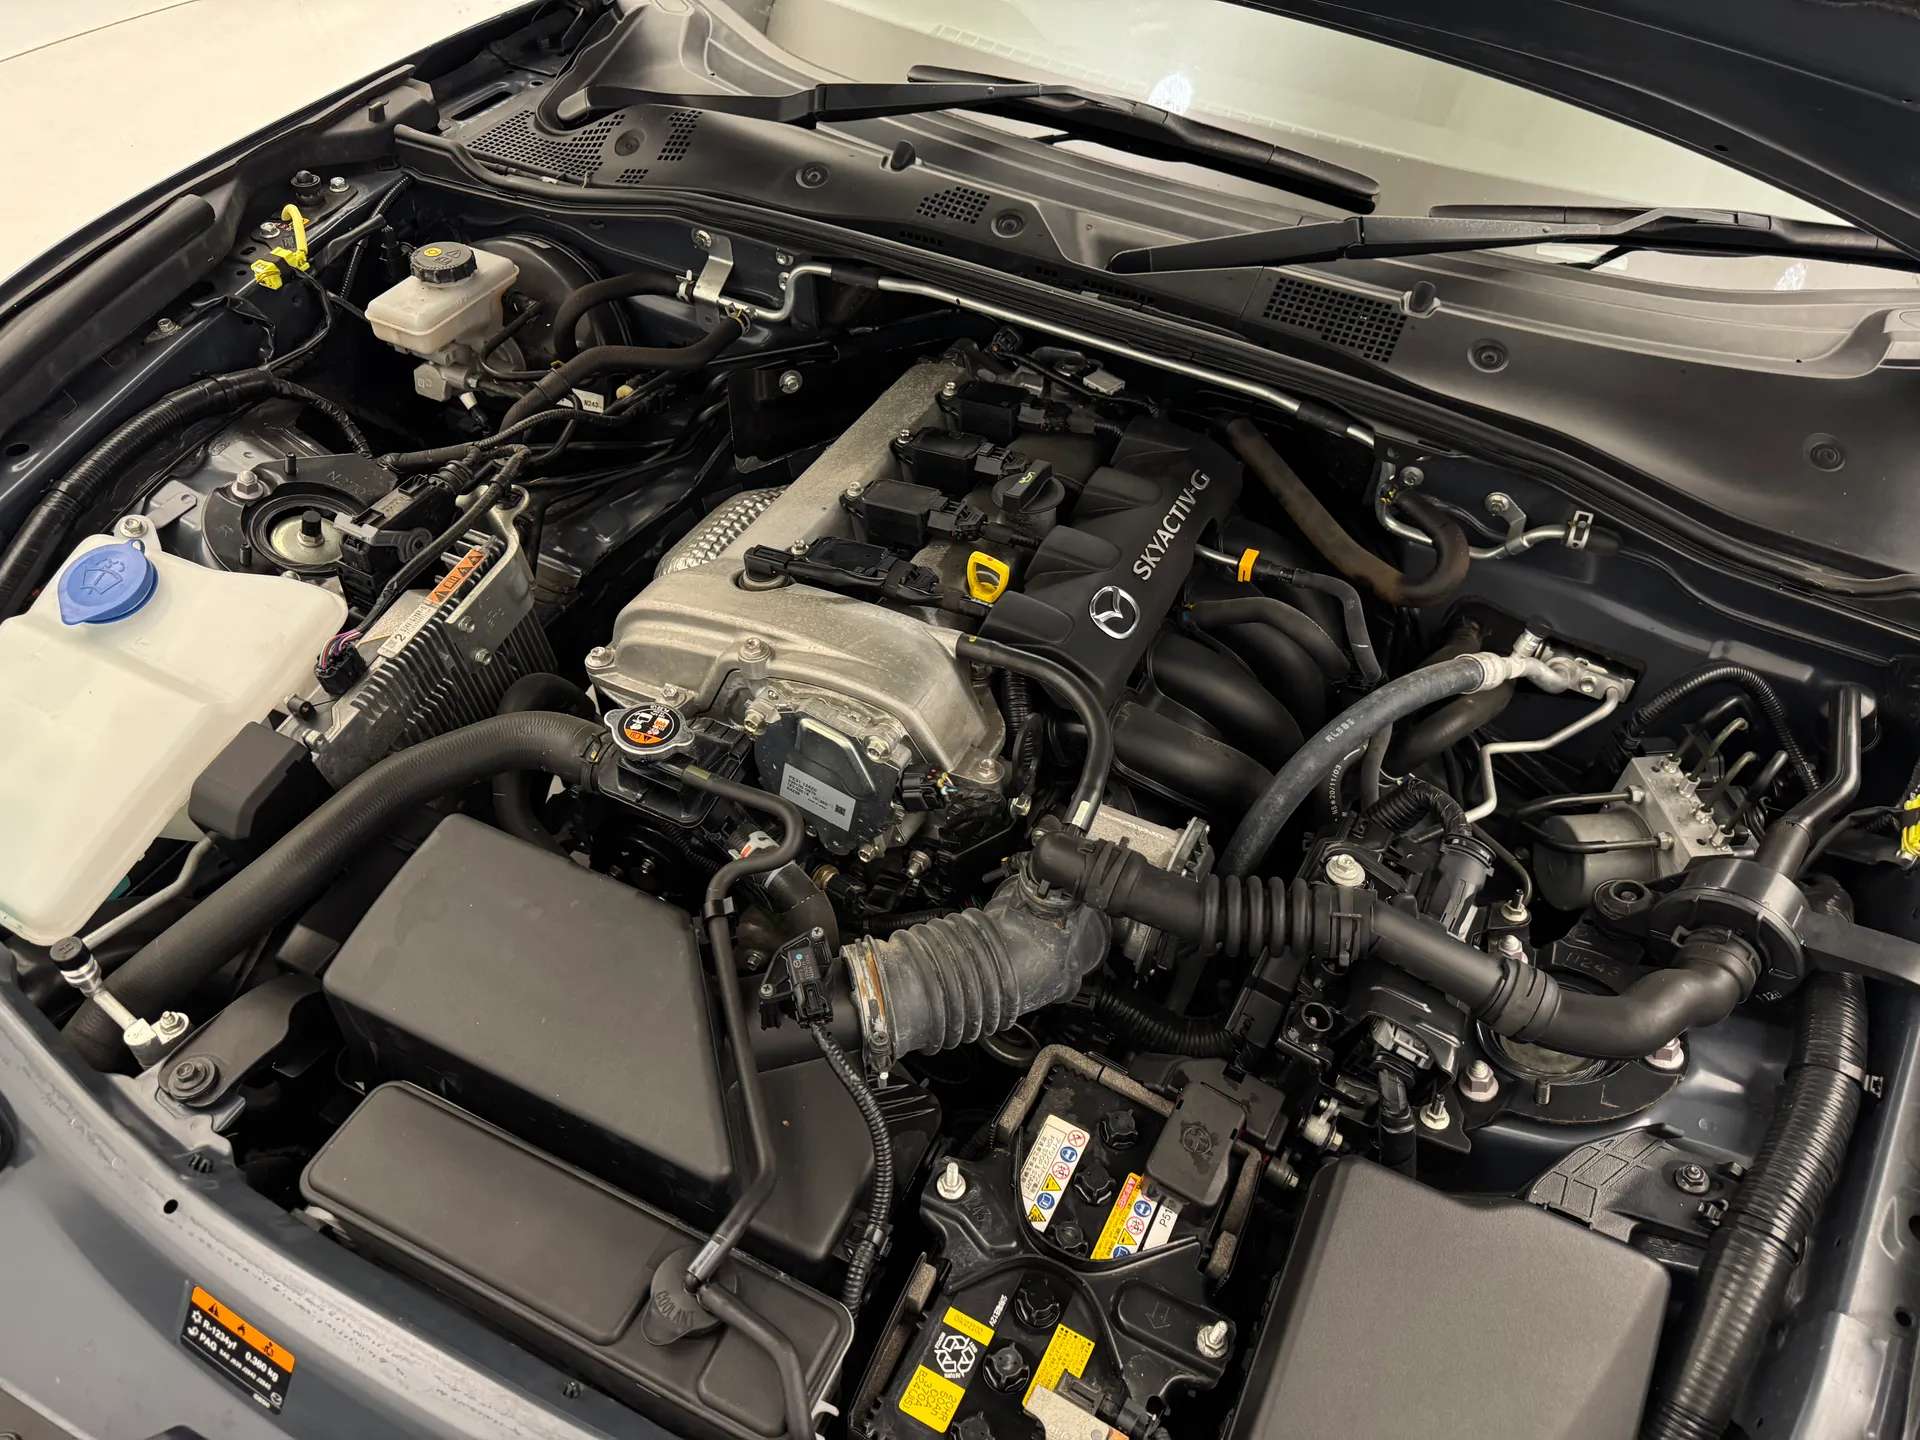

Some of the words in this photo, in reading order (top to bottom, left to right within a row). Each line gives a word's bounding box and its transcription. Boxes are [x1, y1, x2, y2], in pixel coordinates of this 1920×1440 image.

[1133, 469, 1210, 580] SKYACTIV-G
[199, 1332, 218, 1352] PAG
[267, 1367, 279, 1382] kg
[914, 1380, 932, 1407] 370A
[923, 1388, 939, 1409] CCA
[930, 1390, 948, 1416] 50Ah
[938, 1394, 957, 1422] 20HR
